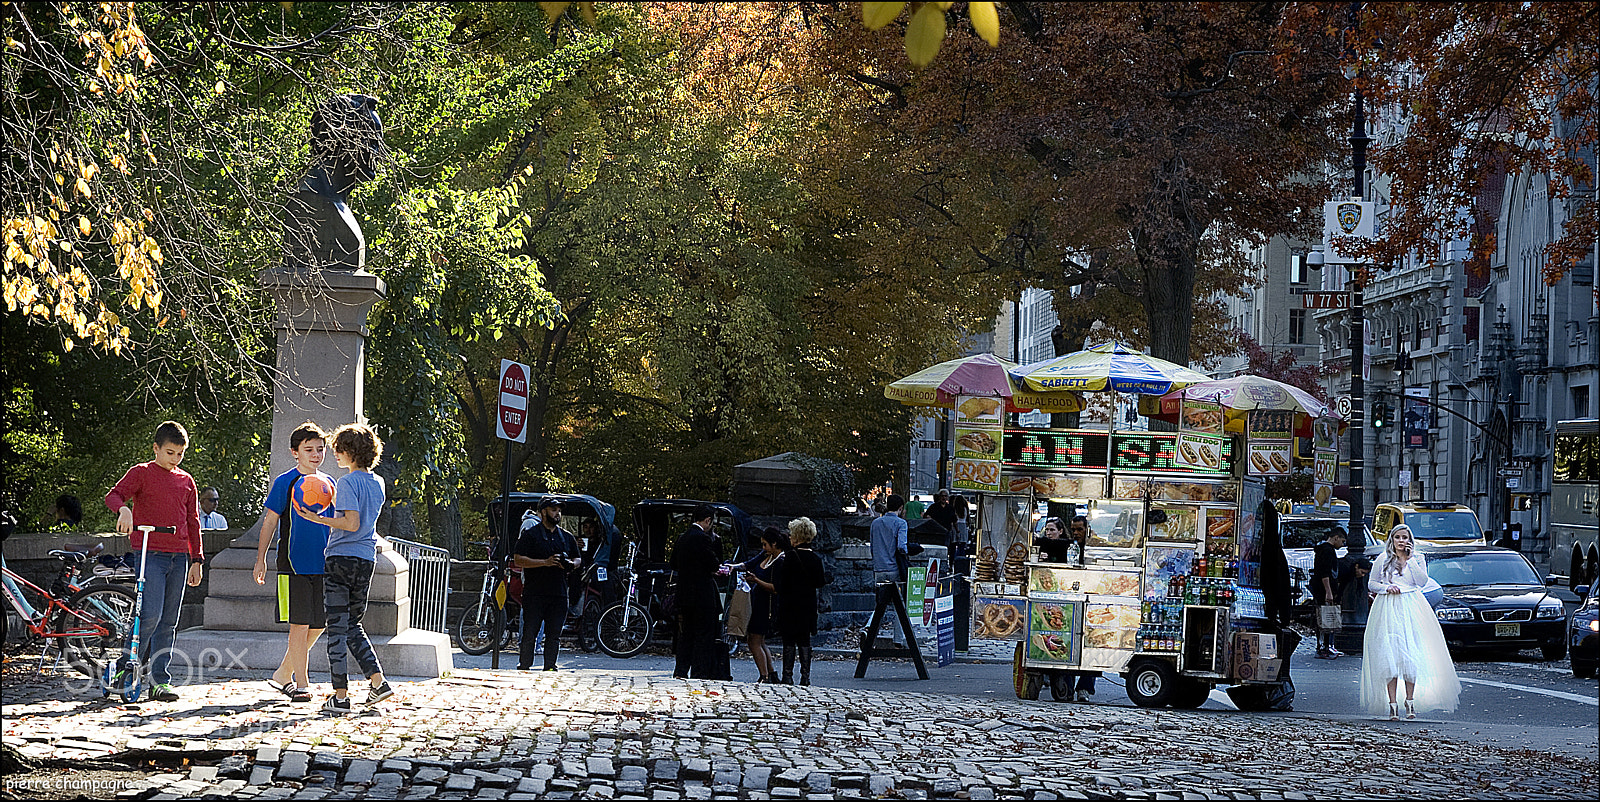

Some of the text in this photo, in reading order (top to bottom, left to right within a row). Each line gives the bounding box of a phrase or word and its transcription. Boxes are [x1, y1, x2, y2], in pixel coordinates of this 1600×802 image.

[1305, 294, 1348, 307] W 77 ST
[505, 376, 525, 392] DO NOT
[1041, 378, 1089, 387] SABRETT
[889, 388, 935, 401] HALAL FOOD
[1017, 395, 1073, 407] HALAL FOOD
[504, 411, 521, 425] ENTER
[1182, 435, 1219, 445] CHILI DOG
[1021, 435, 1084, 465] AN
